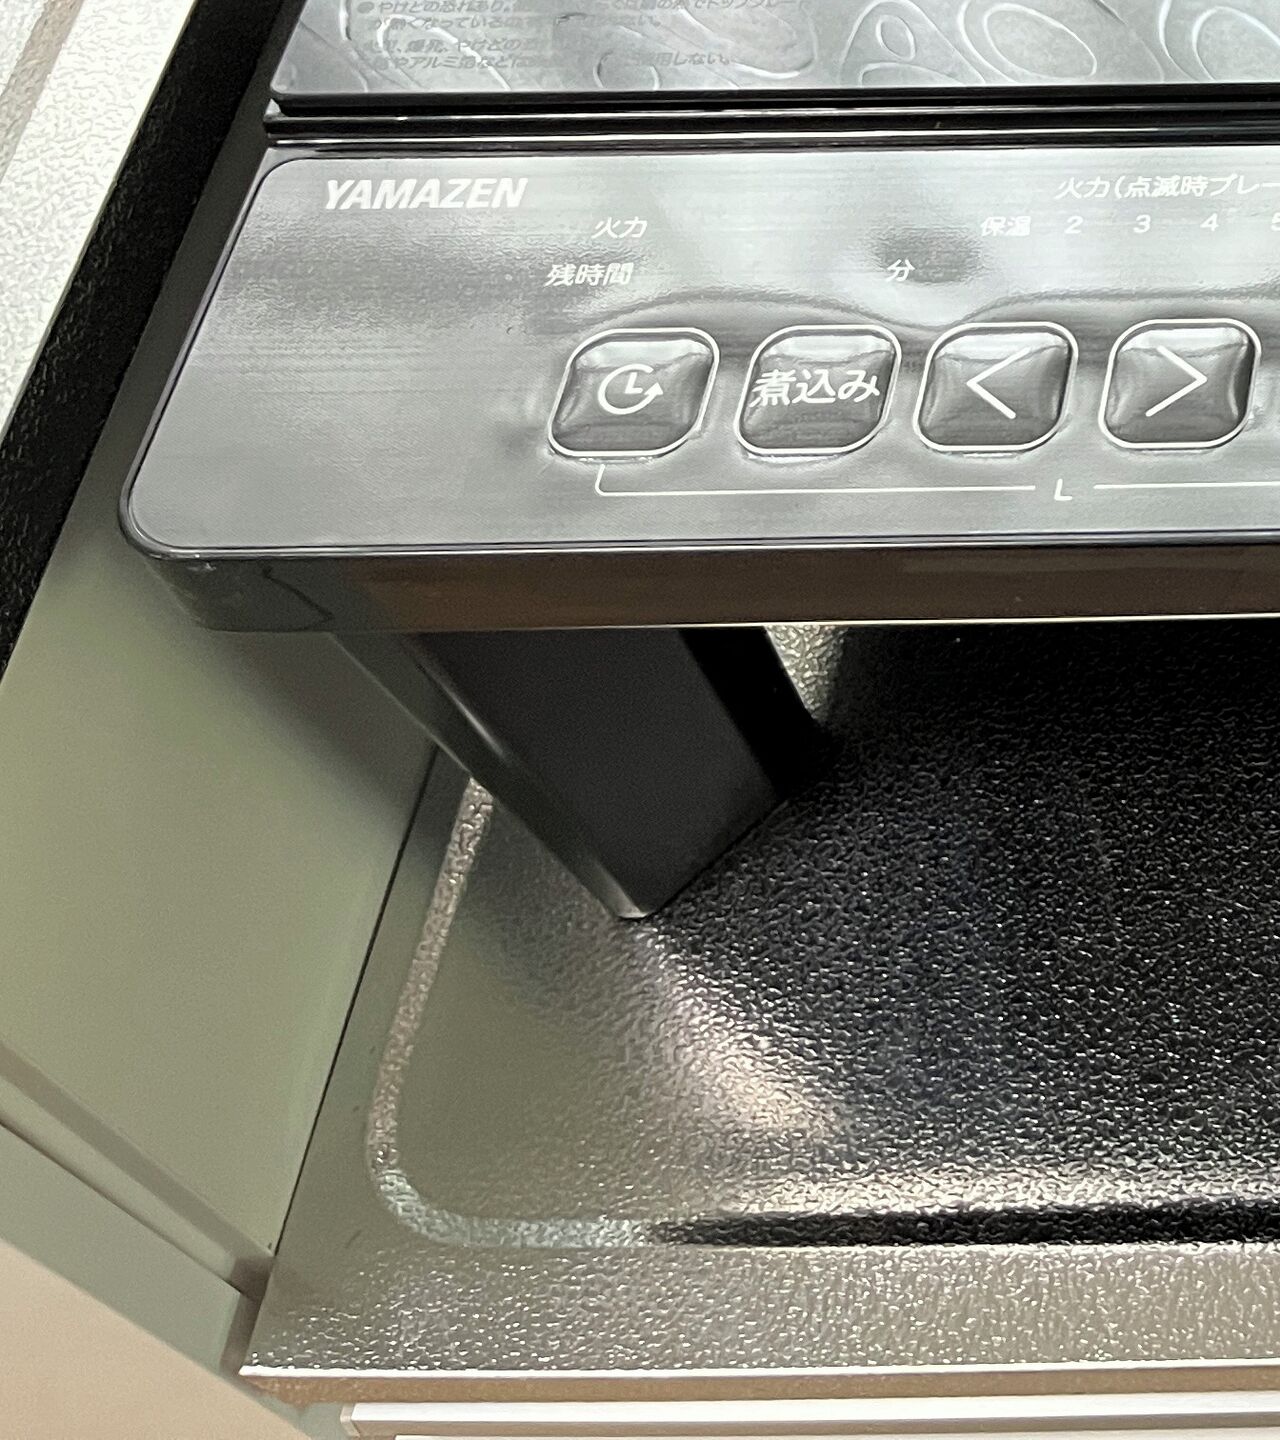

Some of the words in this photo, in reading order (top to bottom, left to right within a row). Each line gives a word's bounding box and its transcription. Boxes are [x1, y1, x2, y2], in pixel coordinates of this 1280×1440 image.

[324, 177, 527, 210] YAMAZEN
[592, 216, 649, 239] 火力
[980, 215, 1031, 237] 保温
[1064, 216, 1084, 234] 2
[1133, 215, 1151, 233] 3
[1200, 213, 1219, 231] 4
[545, 263, 634, 287] 残時間
[885, 259, 915, 282] 分
[749, 368, 880, 408] 煮込み
[1053, 478, 1073, 501] L
